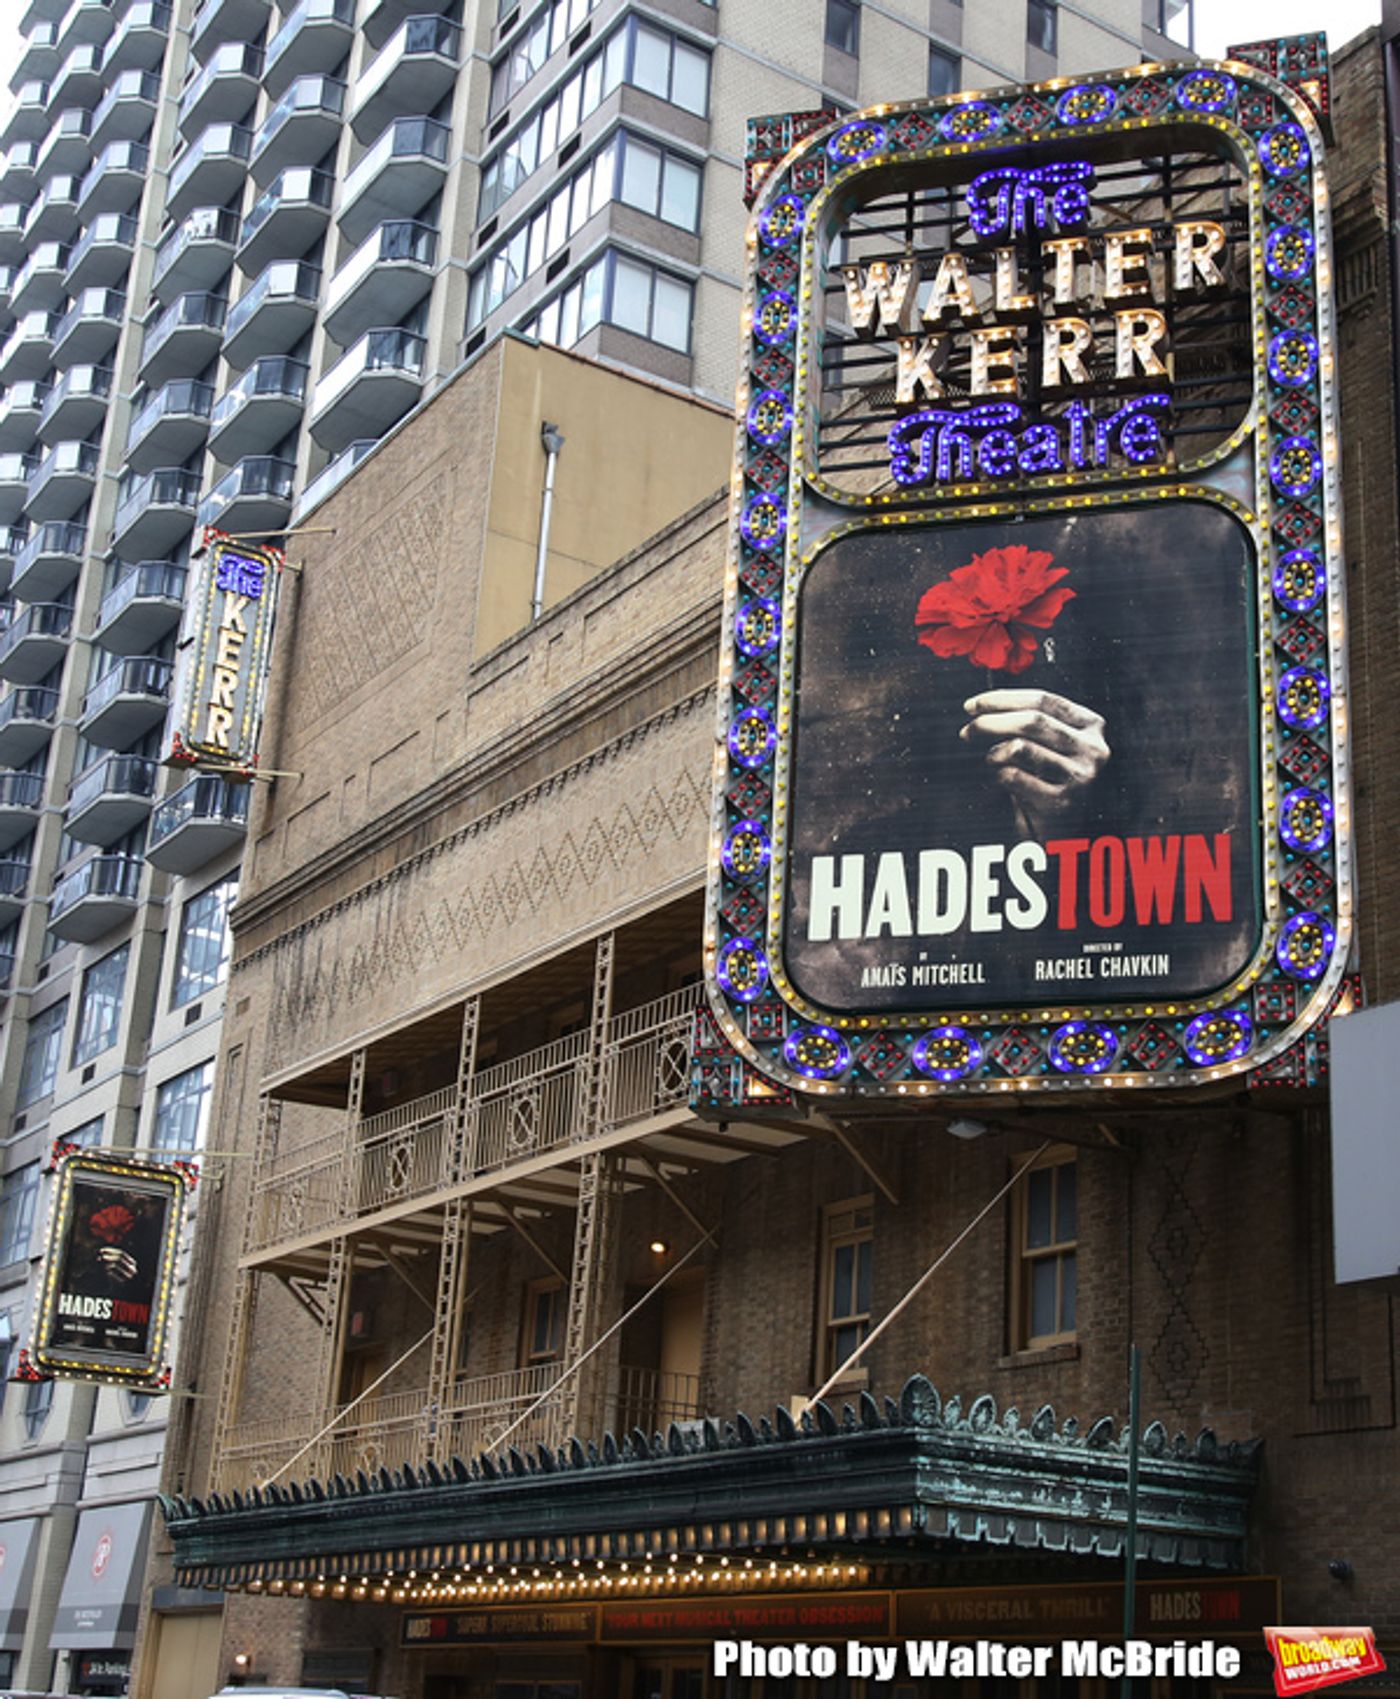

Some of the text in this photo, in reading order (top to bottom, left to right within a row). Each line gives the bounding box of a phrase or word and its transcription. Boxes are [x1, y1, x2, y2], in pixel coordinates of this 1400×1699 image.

[968, 160, 1096, 237] The
[842, 220, 1230, 338] WALTER
[896, 308, 1172, 404] KERR
[889, 394, 1172, 486] Theatre
[216, 552, 266, 600] The
[203, 590, 249, 750] KERR
[912, 963, 986, 987] MITCHELL
[1035, 954, 1170, 981] RACHEL CHAVKIN
[946, 1598, 1035, 1621] VISCERAL
